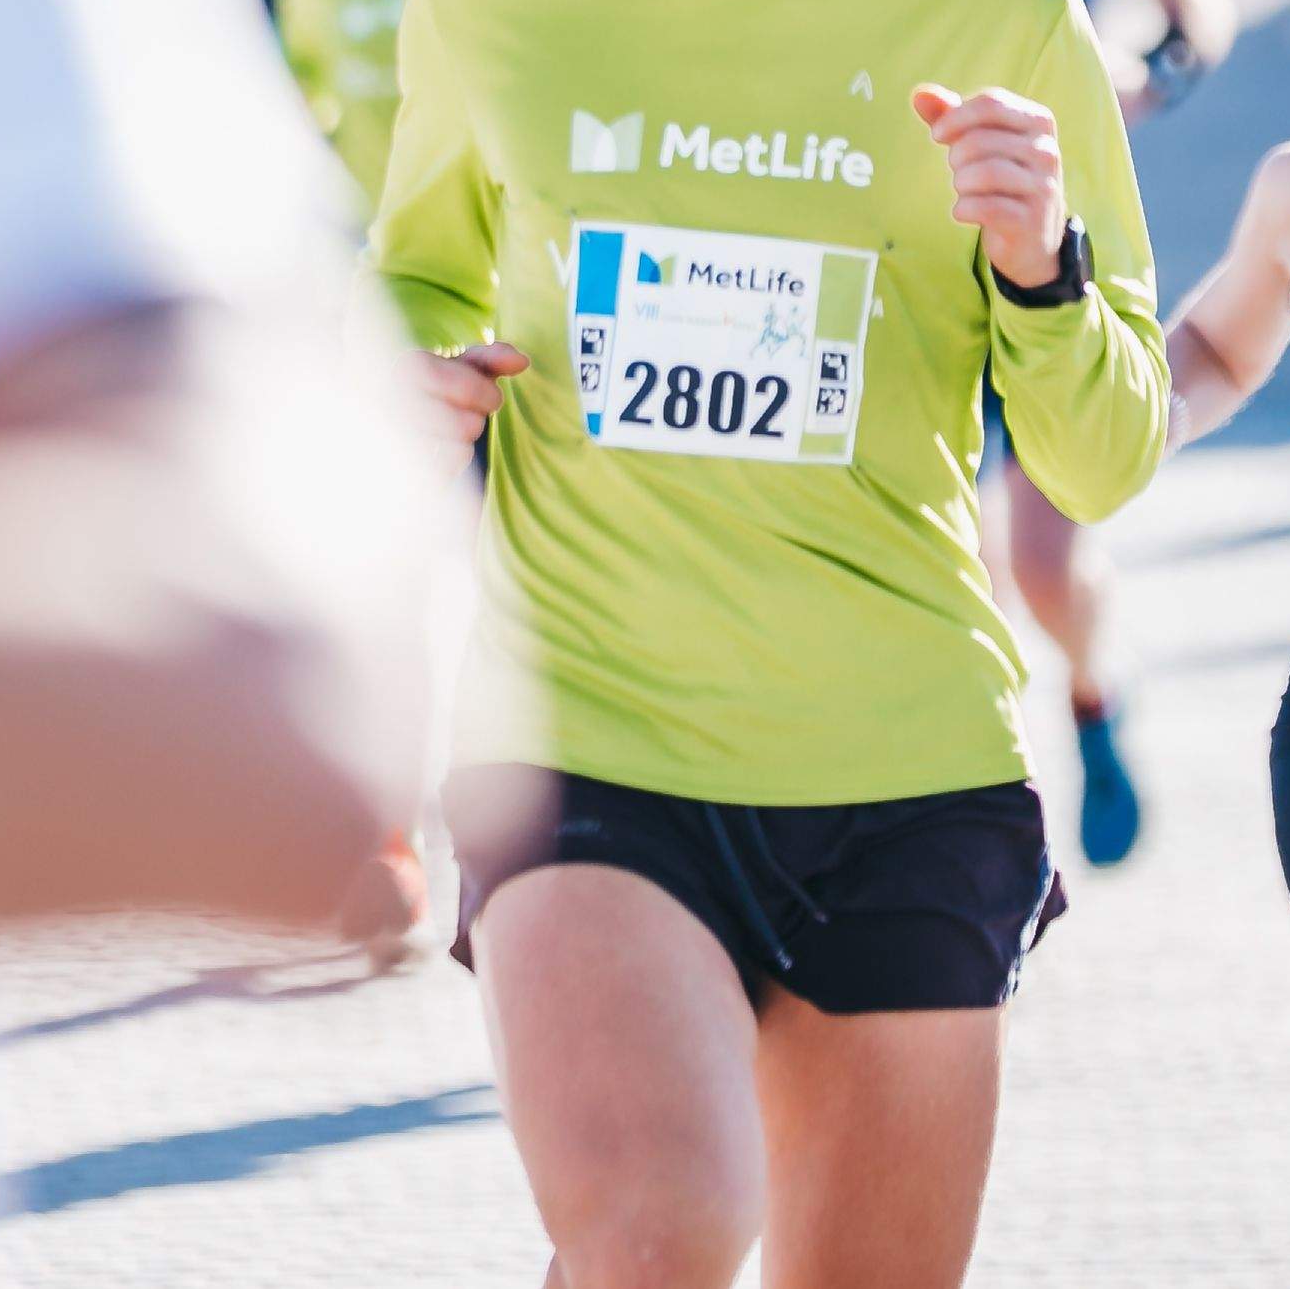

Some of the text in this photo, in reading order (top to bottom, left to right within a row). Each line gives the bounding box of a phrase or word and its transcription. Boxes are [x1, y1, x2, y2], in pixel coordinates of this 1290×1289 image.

[660, 122, 874, 187] MetLife
[688, 261, 806, 297] MetLife
[619, 360, 789, 438] 2802
